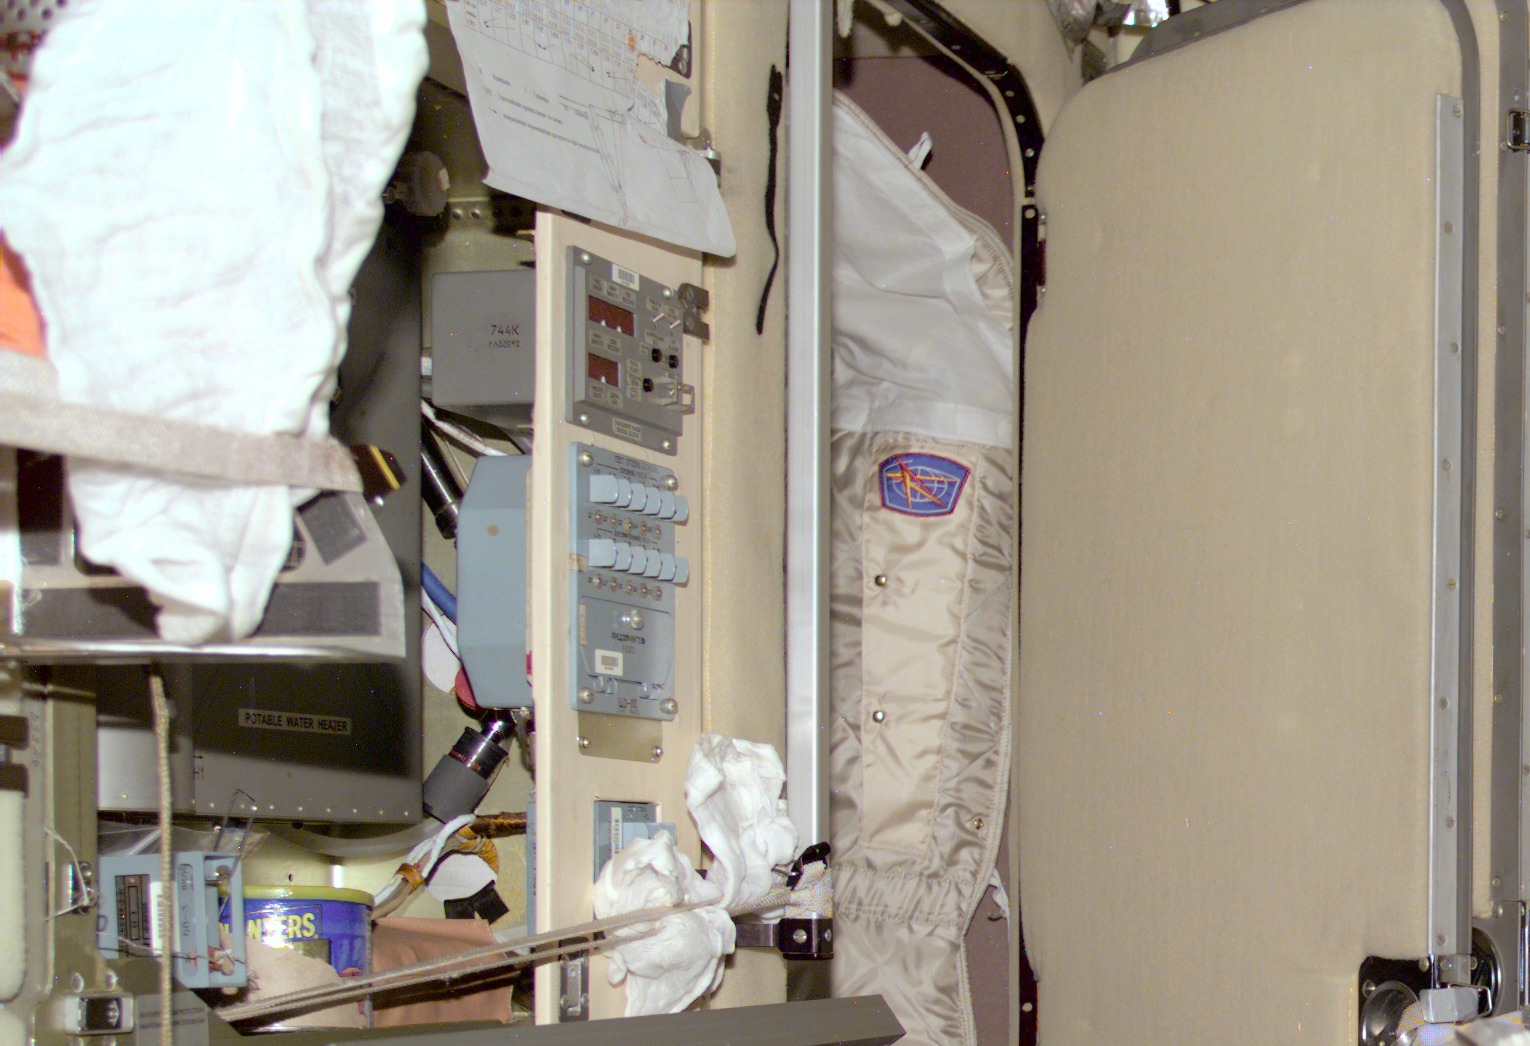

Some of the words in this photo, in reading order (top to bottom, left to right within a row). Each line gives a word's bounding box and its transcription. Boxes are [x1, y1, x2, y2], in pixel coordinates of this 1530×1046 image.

[244, 712, 284, 727] POTABLE
[286, 716, 315, 730] WATER
[317, 719, 349, 733] HEATER
